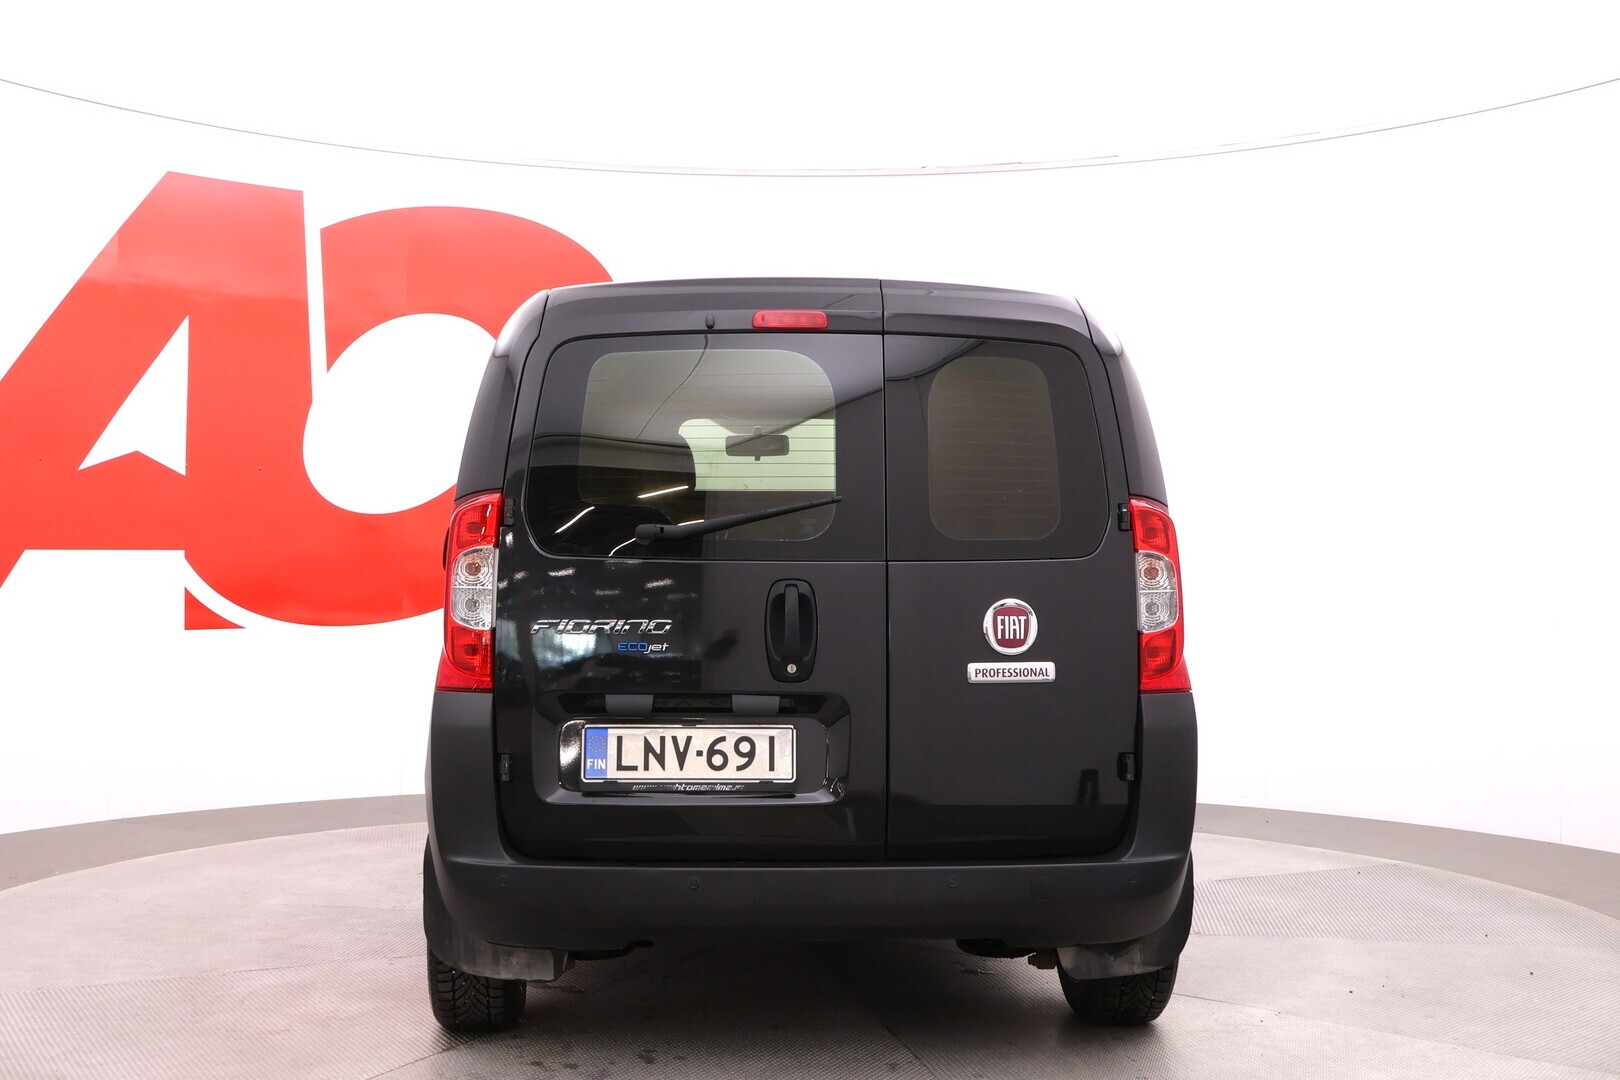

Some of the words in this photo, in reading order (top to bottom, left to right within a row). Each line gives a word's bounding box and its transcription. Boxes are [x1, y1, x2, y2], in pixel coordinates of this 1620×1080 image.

[530, 618, 673, 635] FIORINO
[996, 615, 1027, 640] FIAT
[617, 641, 670, 654] ECOjet
[974, 667, 1050, 678] PROFESSIONAL
[616, 735, 775, 772] LNV-691
[586, 758, 606, 770] FIN
